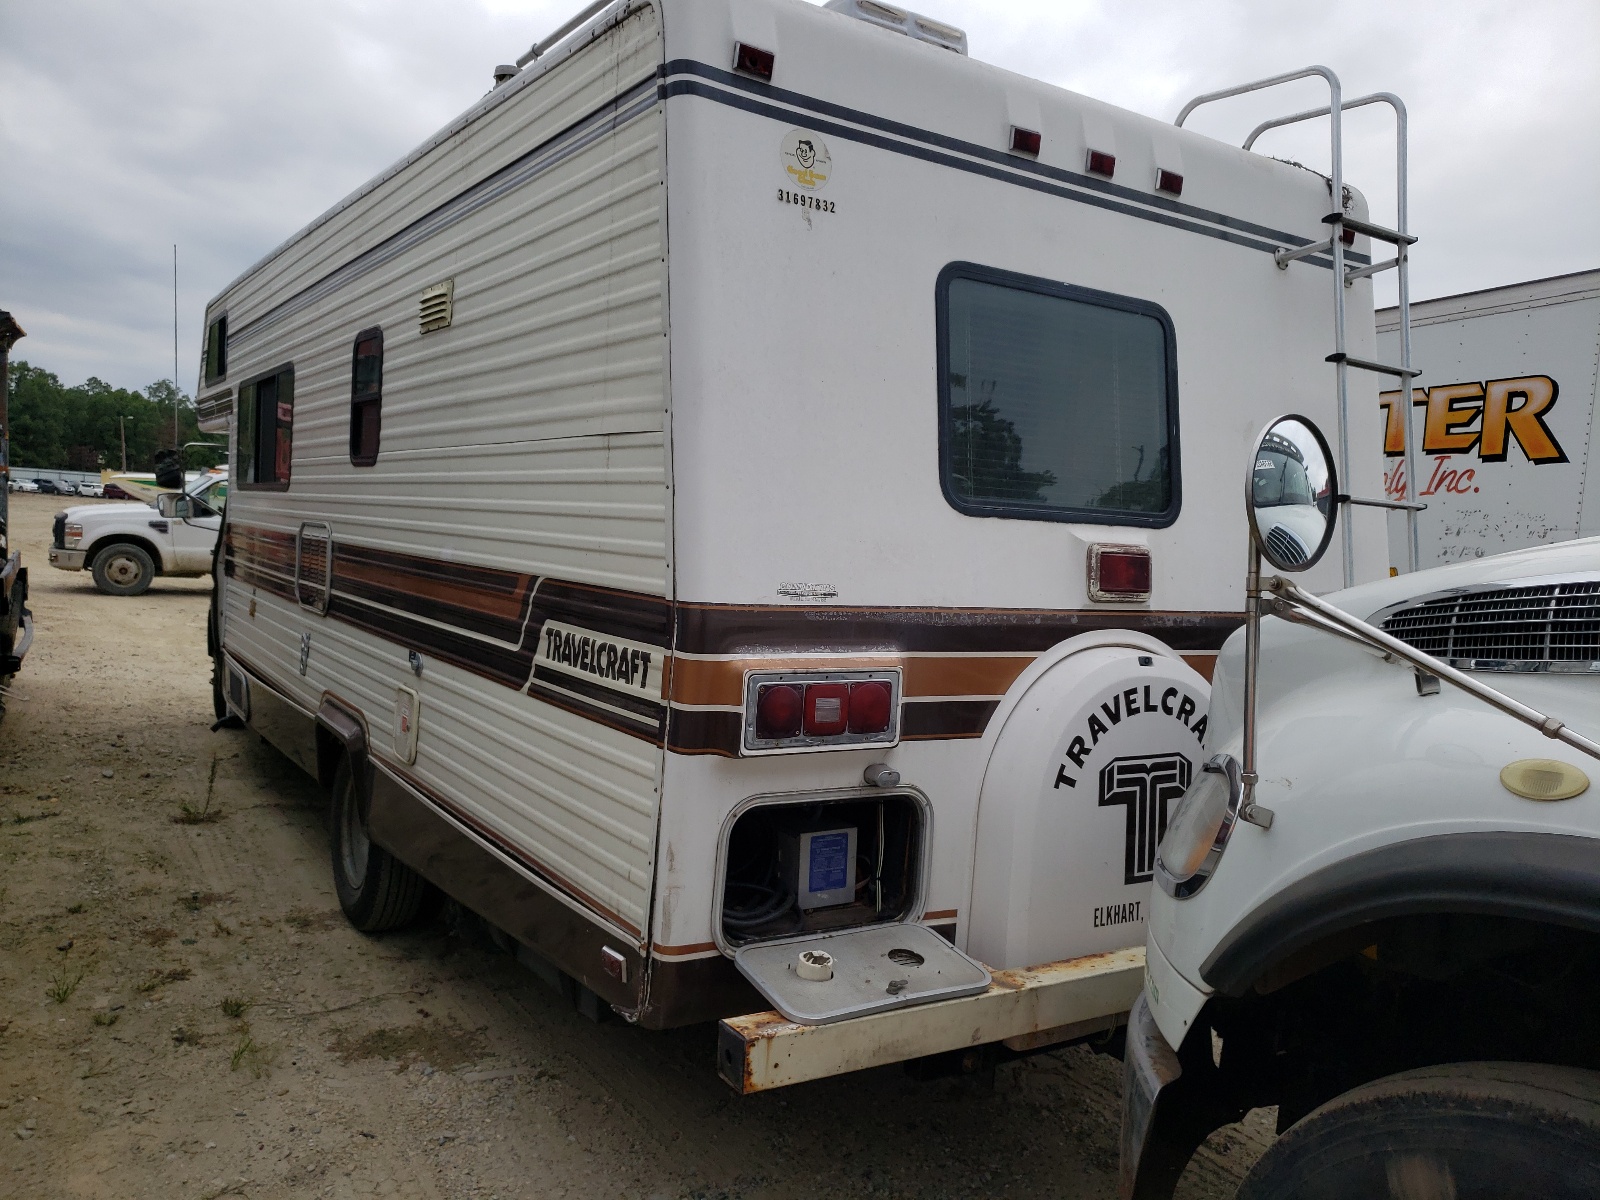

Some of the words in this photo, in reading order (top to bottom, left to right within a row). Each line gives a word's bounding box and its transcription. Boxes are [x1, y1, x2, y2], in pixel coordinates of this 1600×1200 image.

[777, 189, 836, 214] 31697832
[1379, 374, 1570, 466] TER
[1418, 455, 1480, 496] Inc.
[545, 627, 651, 689] TRAVELCRAFT
[1053, 684, 1208, 790] TRAVELCRA
[1093, 901, 1144, 928] ELKHART,
